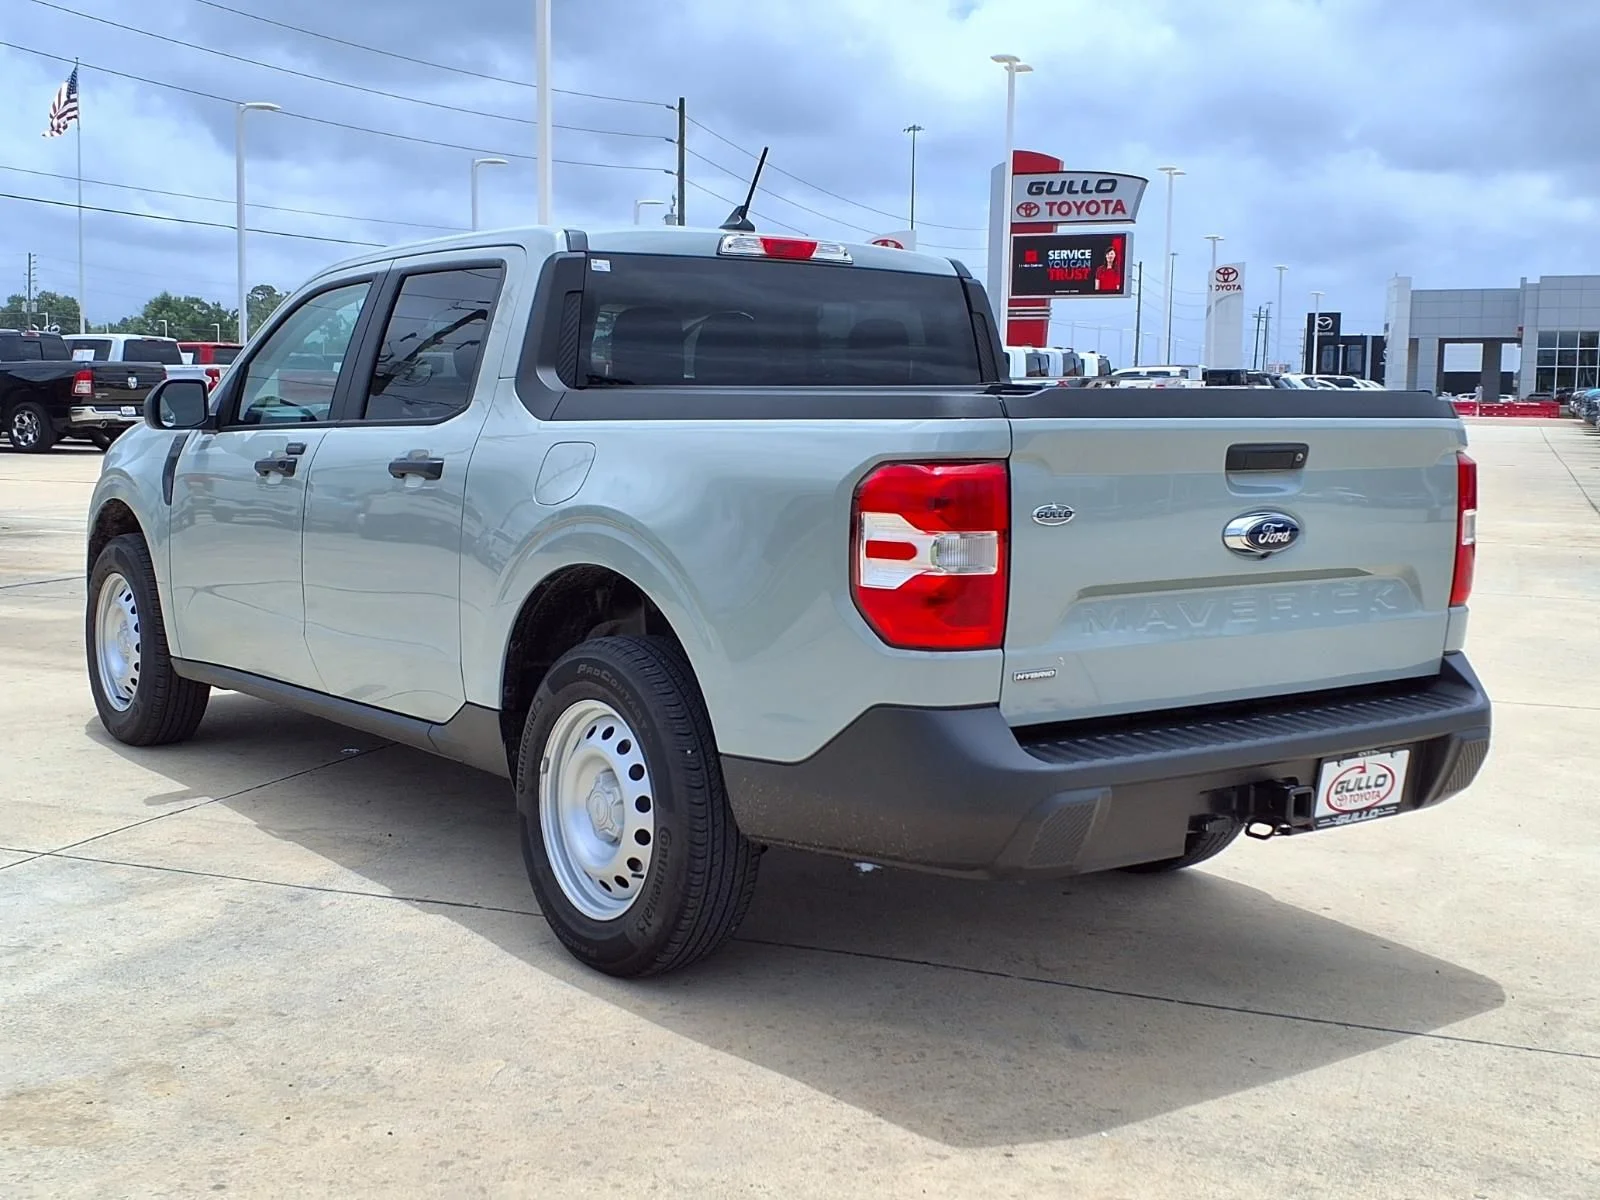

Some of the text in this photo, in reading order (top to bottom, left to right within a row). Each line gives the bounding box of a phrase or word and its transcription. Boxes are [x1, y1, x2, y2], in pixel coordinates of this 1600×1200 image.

[1027, 178, 1118, 196] GULLO
[1045, 199, 1126, 217] TOYOTA
[1047, 249, 1092, 260] SERVICE
[1048, 260, 1067, 268] YOU
[1070, 259, 1091, 268] CAN
[1047, 268, 1091, 280] TRUST
[1036, 510, 1073, 519] GULLO
[1258, 523, 1290, 544] Ford
[1082, 583, 1398, 636] MAVERICK
[1016, 671, 1055, 680] HYBRID
[1334, 774, 1388, 795] GULLO
[1348, 790, 1381, 803] TOYOTA
[1334, 809, 1380, 825] GULLO
